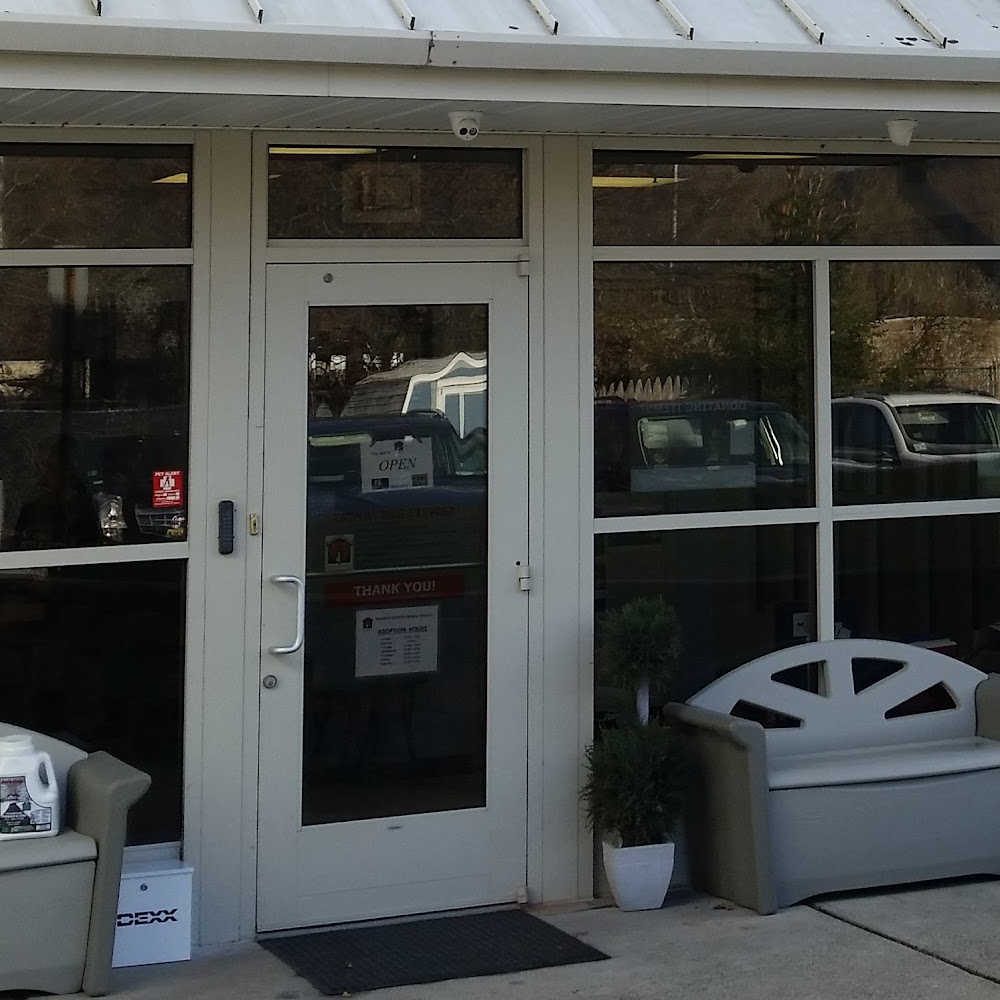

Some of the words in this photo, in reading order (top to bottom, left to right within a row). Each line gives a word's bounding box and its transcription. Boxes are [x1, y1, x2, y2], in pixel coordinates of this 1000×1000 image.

[379, 458, 417, 472] OPEN
[353, 583, 400, 596] THANK
[404, 580, 436, 592] YOU!
